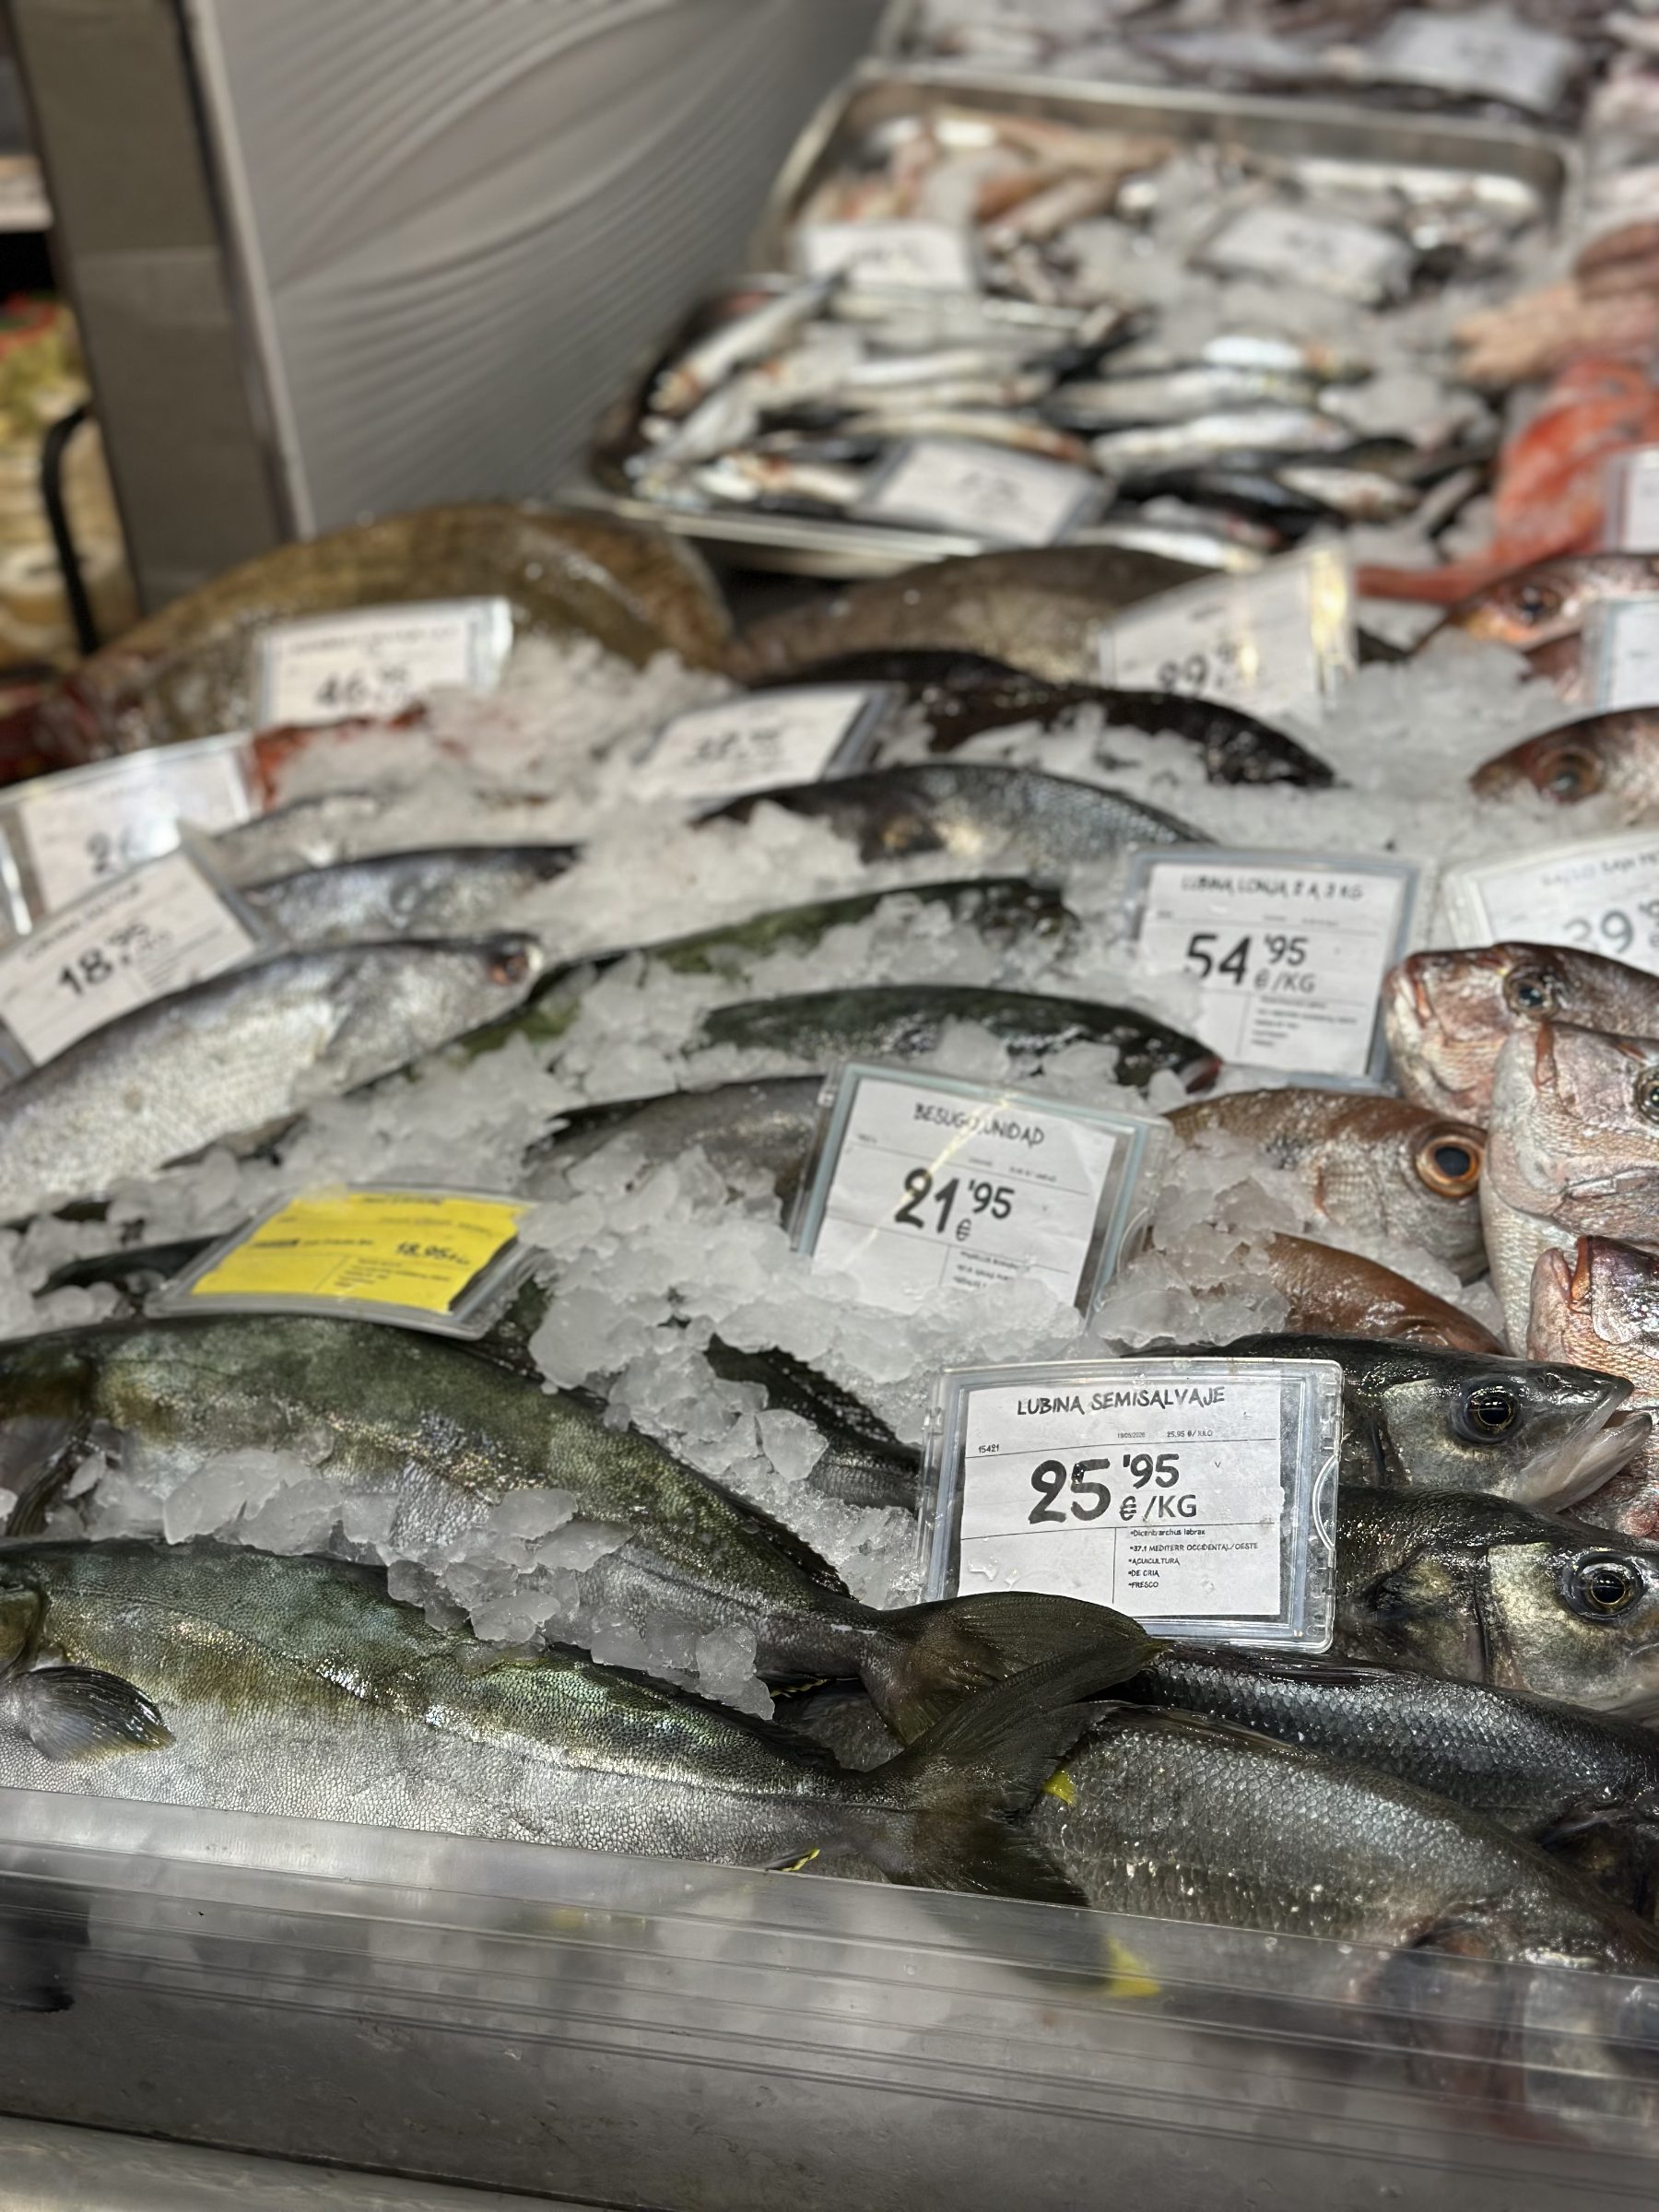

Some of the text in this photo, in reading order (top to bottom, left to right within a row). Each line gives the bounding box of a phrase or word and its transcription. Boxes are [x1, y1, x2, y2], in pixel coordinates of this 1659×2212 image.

[59, 947, 114, 995] 18
[1184, 932, 1252, 987] 54
[894, 1166, 1016, 1234] 21 '95
[955, 1218, 972, 1242] €
[1017, 1386, 1225, 1416] LUBINA SEMISALVAJE
[978, 1443, 1000, 1453] 15421
[1028, 1453, 1180, 1524] 25 '95
[1183, 1528, 1206, 1536] labrax
[1148, 1544, 1184, 1552] MEDITERR
[1132, 1558, 1181, 1566] ACUICULTURA
[1131, 1581, 1159, 1589] FRESCO
